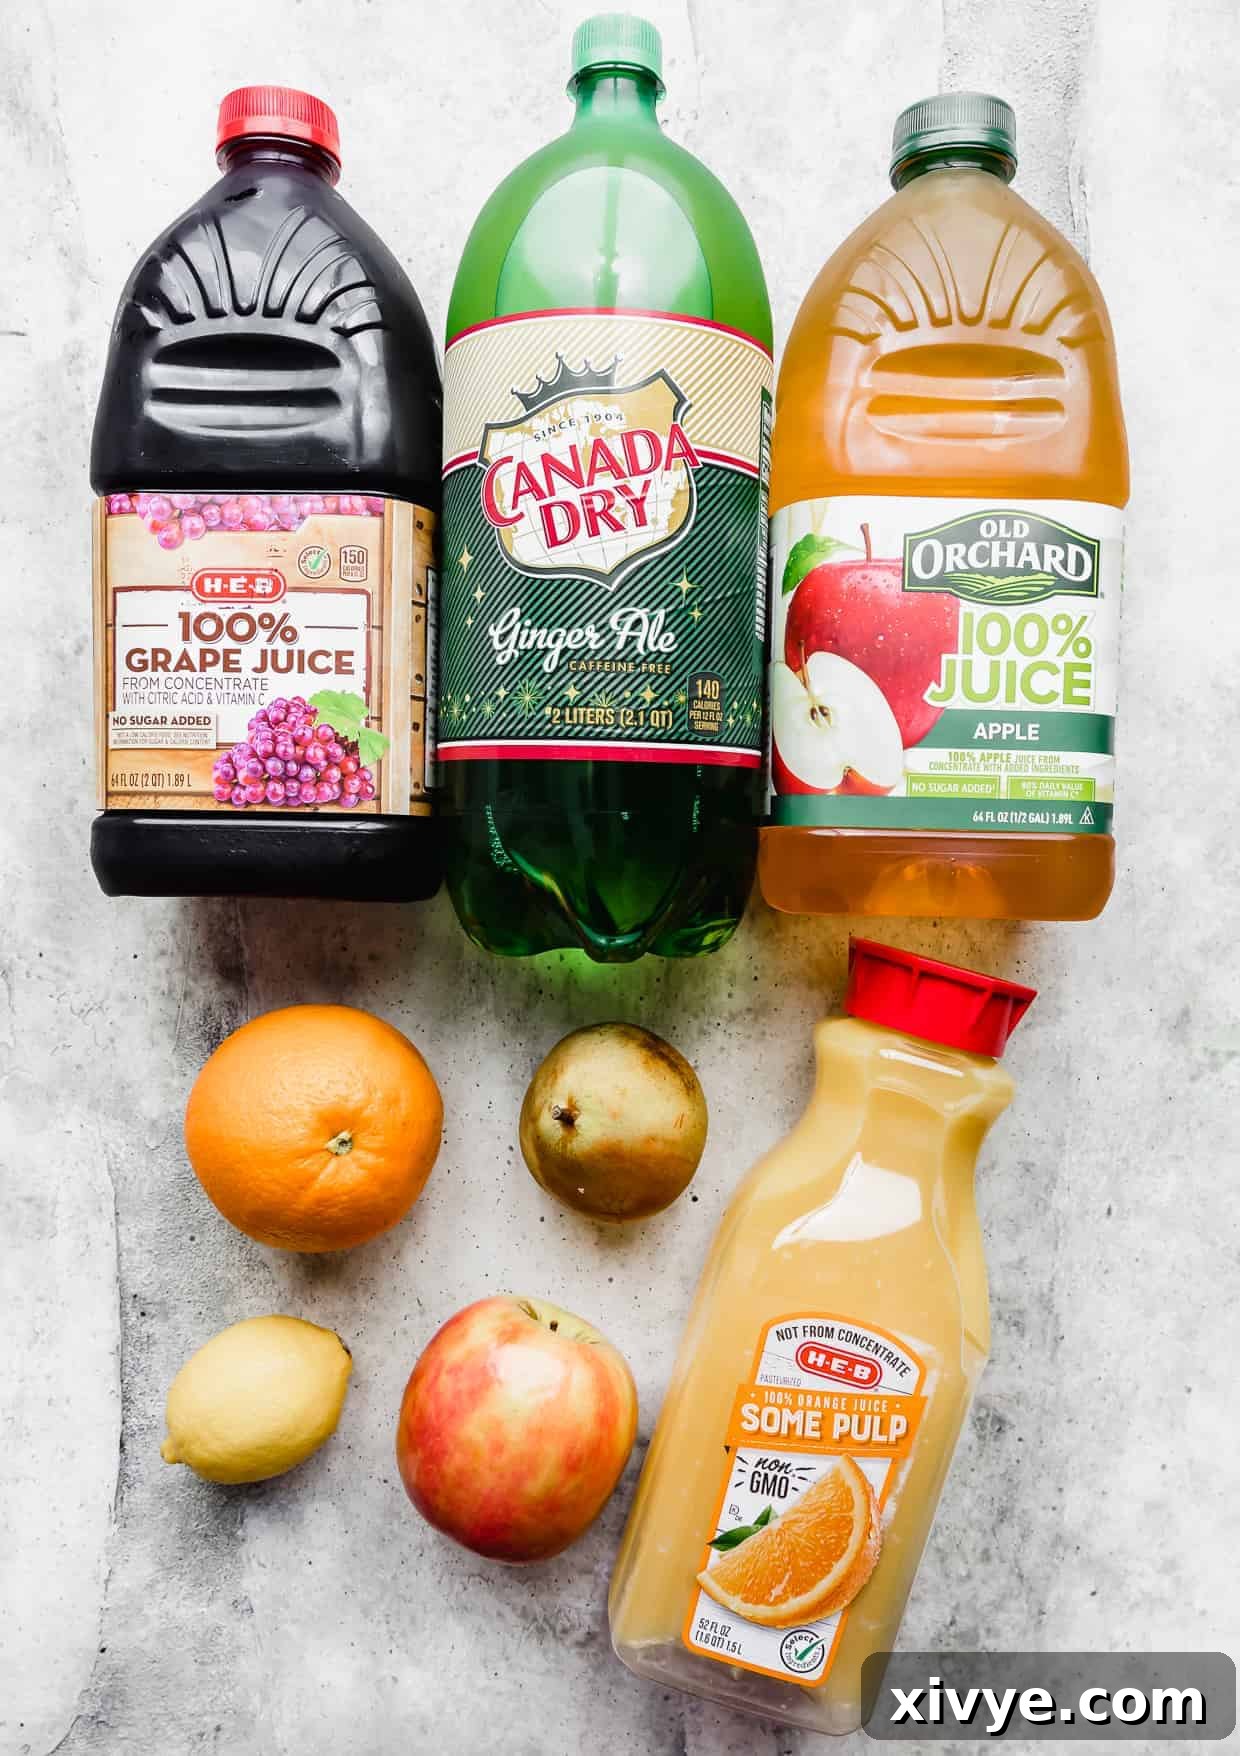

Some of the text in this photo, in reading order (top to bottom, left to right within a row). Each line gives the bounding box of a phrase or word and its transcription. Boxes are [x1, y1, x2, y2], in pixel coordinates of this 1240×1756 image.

[534, 413, 623, 441] SINCE 1904
[481, 422, 702, 528] CANADA
[540, 480, 651, 548] DRY
[979, 519, 1030, 539] OLD
[342, 549, 365, 564] 150
[911, 538, 1093, 582] ORCHARD
[178, 611, 299, 644] 100%
[962, 611, 1092, 659] 100%
[488, 607, 678, 673] Ginger Ale
[125, 647, 355, 675] GRAPE JUICE
[569, 660, 672, 675] CAFFEINE FREE
[122, 676, 269, 691] FROM CONCENTRATE
[696, 679, 720, 700] 140
[927, 659, 1092, 706] JUICE
[122, 692, 265, 706] WITH CITRIC ACID & VITAMIN C
[112, 715, 212, 727] NO SUGAR ADDED
[564, 707, 615, 726] LITERS
[620, 707, 645, 728] (2.1
[650, 710, 673, 730] QT)
[973, 723, 1040, 741] APPLE
[928, 761, 981, 772] CONCENTRATE
[948, 751, 1060, 764] 100% APPLE JUICE FROM
[120, 774, 127, 787] FL
[129, 774, 139, 788] OZ
[167, 774, 185, 788] 1.89
[187, 774, 192, 787] L
[912, 783, 925, 793] NO
[927, 783, 959, 794] SUGAR
[973, 811, 984, 823] 64
[985, 812, 996, 822] FL
[997, 812, 1009, 824] OZ
[1028, 812, 1050, 825] GAL)
[776, 1325, 912, 1379] NOT FROM CONCENTRATE
[764, 1391, 889, 1414] 100% ORANGE JUICE
[741, 1402, 909, 1445] SOME PULP
[749, 1470, 790, 1499] GMO
[698, 1617, 732, 1638] 52 FL OZ
[785, 1634, 816, 1650] Select
